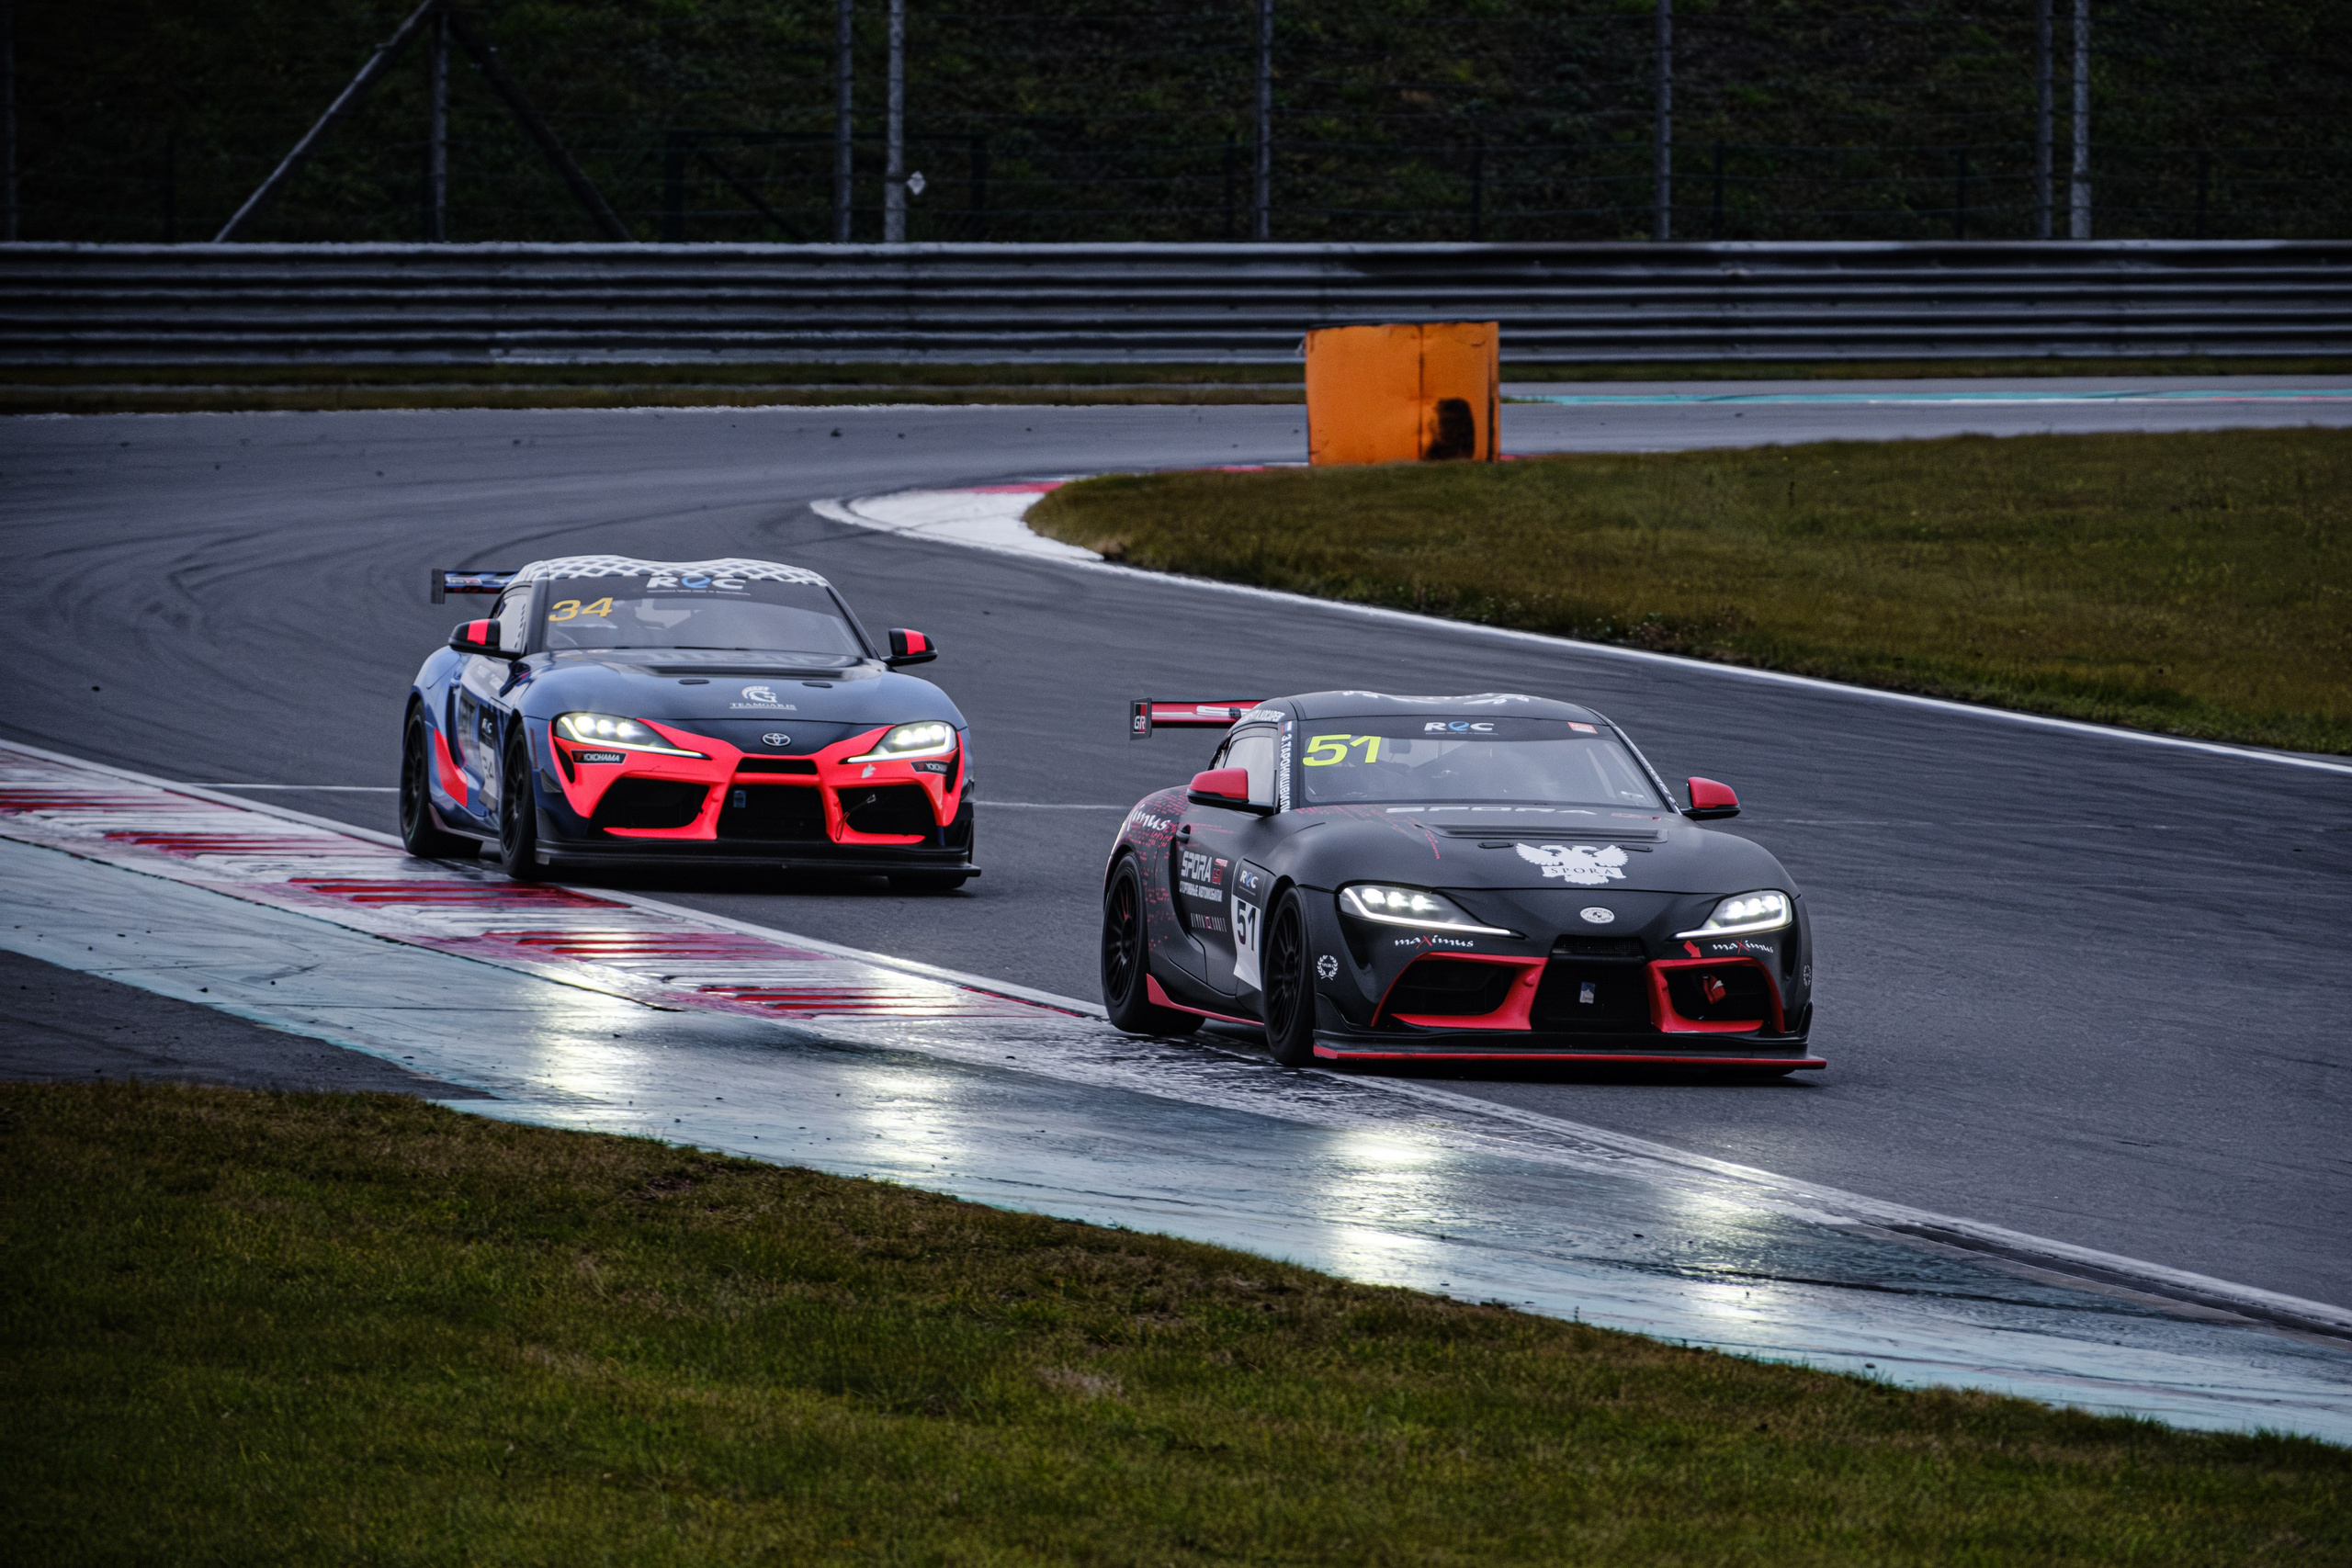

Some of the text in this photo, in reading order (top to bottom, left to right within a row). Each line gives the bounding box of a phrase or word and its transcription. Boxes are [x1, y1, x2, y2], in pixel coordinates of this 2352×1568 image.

[548, 597, 615, 622] 34
[1134, 716, 1146, 729] GR
[1303, 734, 1382, 766] 51
[1181, 851, 1213, 883] SPORA
[1238, 899, 1257, 952] 51
